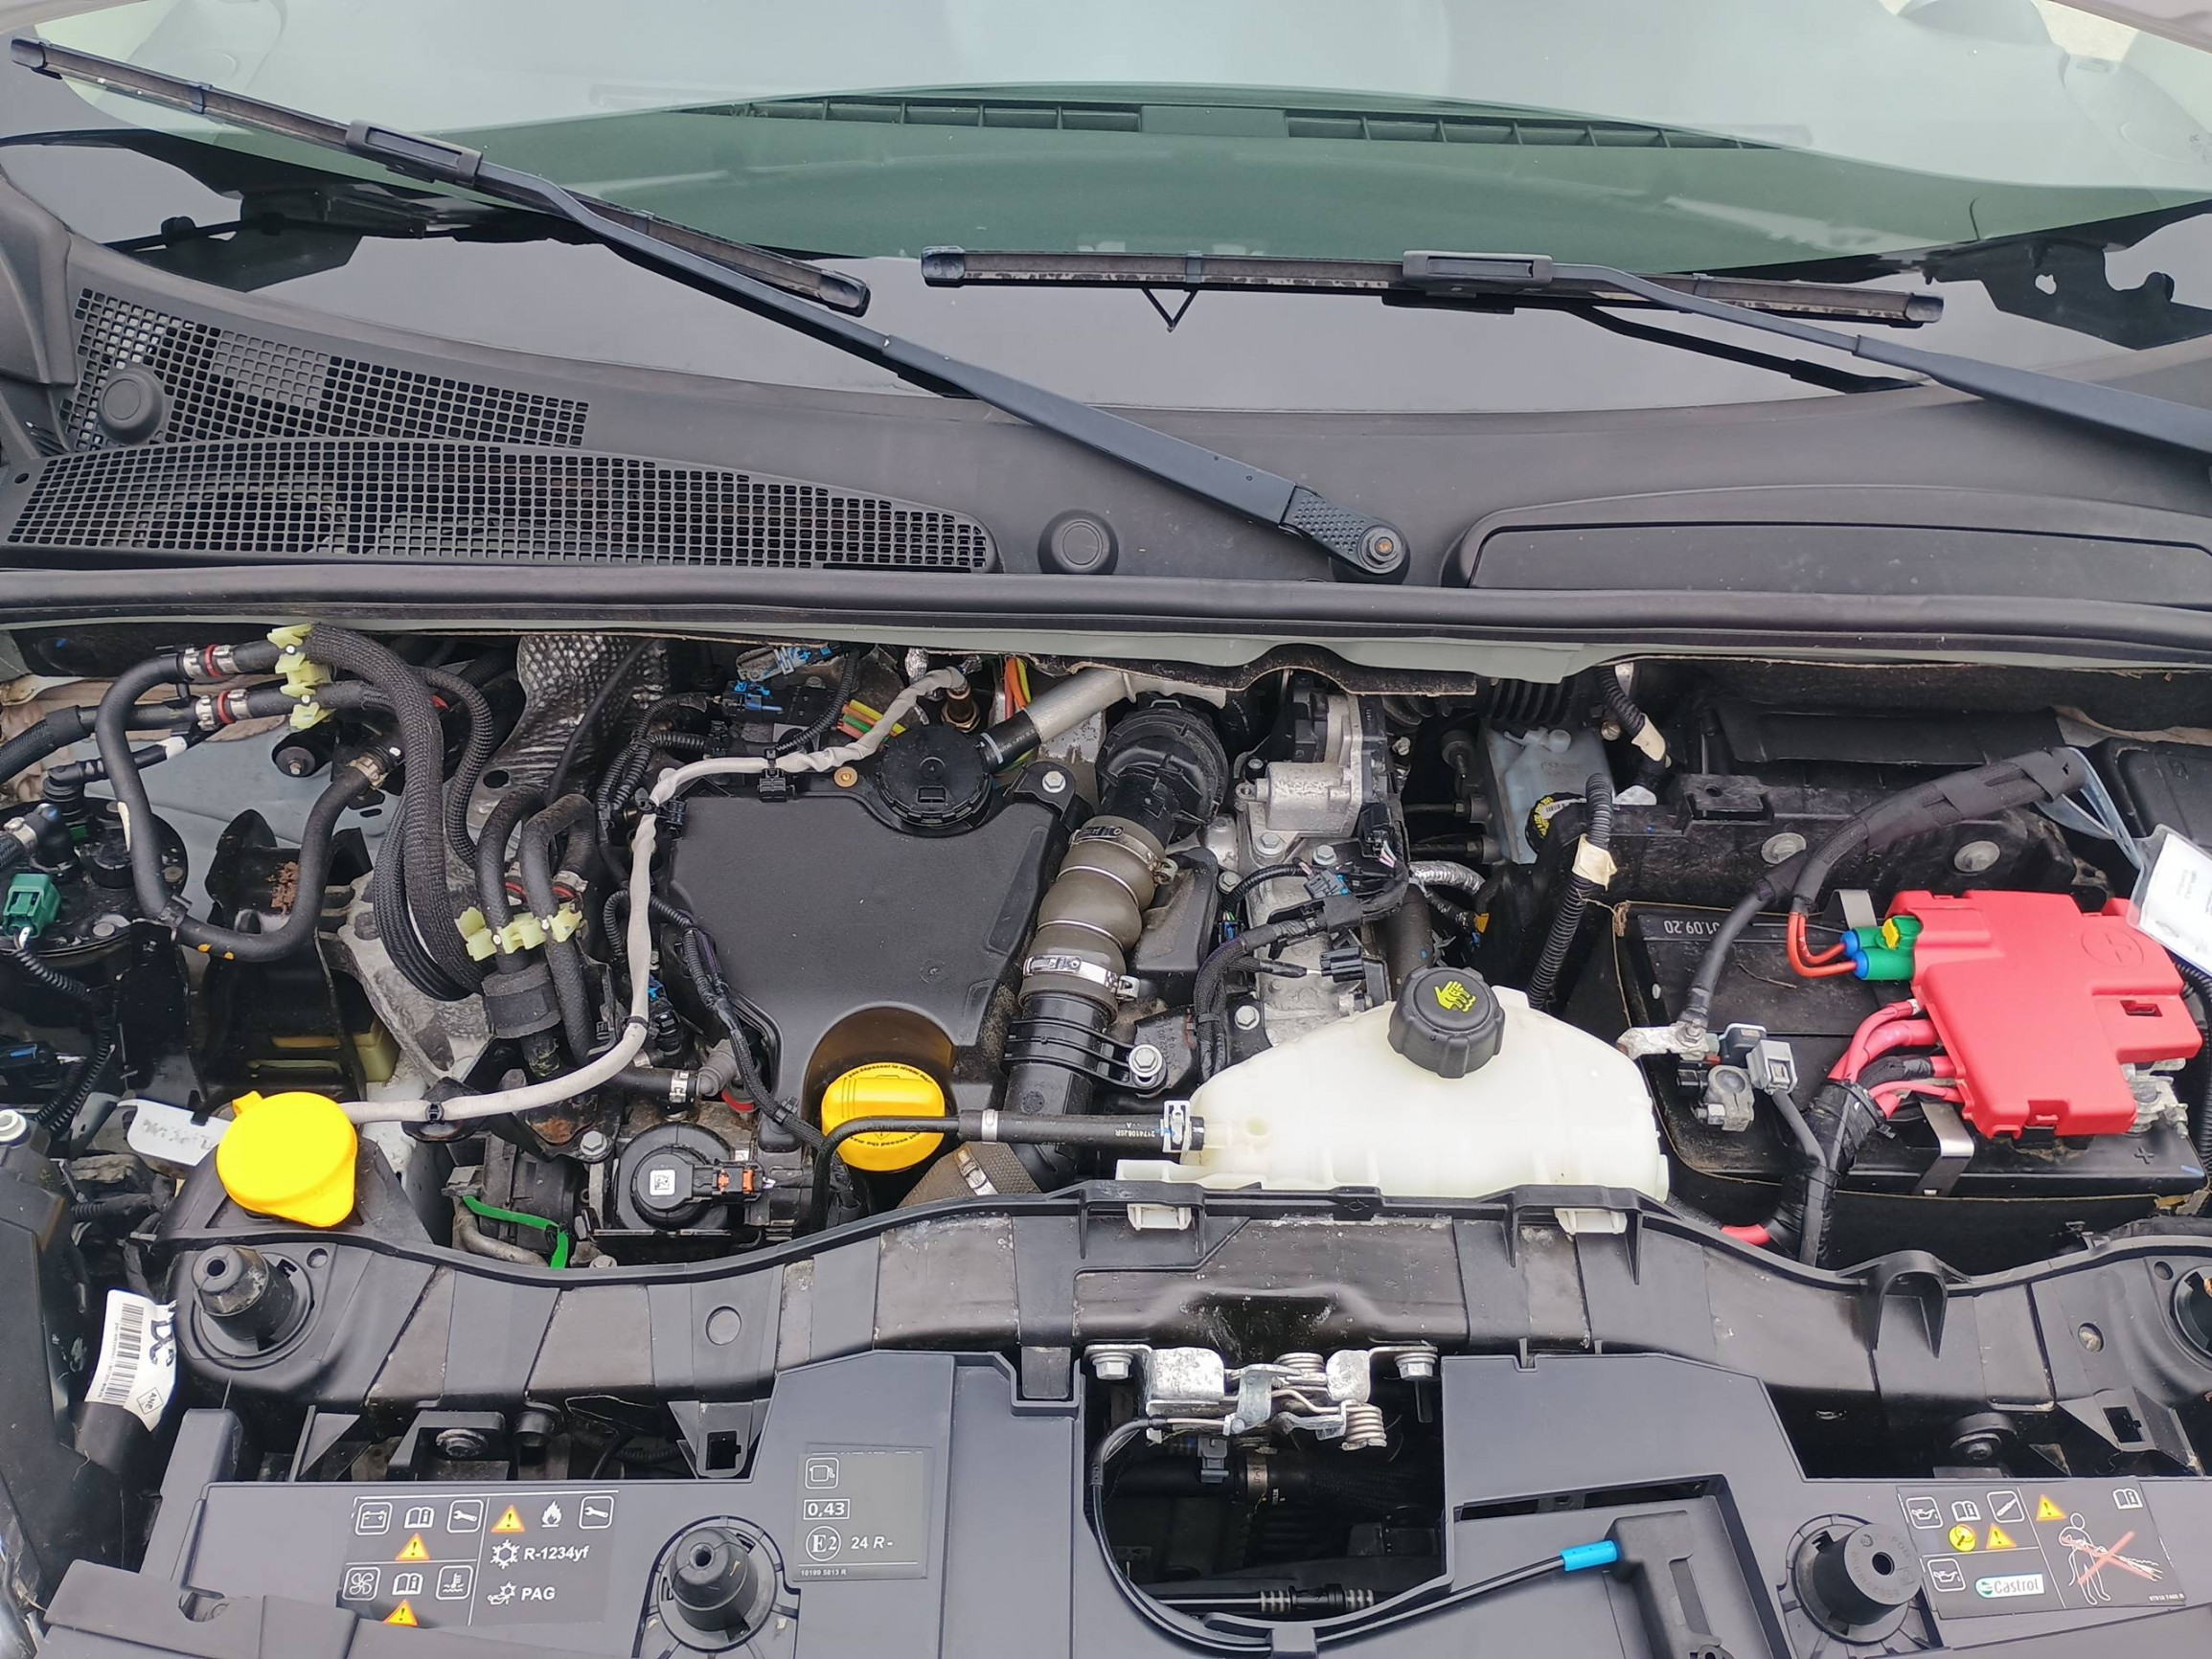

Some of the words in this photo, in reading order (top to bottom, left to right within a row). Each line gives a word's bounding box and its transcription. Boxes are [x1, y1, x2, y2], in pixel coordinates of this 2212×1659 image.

[808, 1502, 845, 1517] 0,43
[811, 1534, 837, 1553] E2
[851, 1536, 868, 1550] 24
[523, 1545, 590, 1562] R-1234yf
[520, 1586, 556, 1602] PAG
[1994, 1578, 2040, 1594] Castrol
